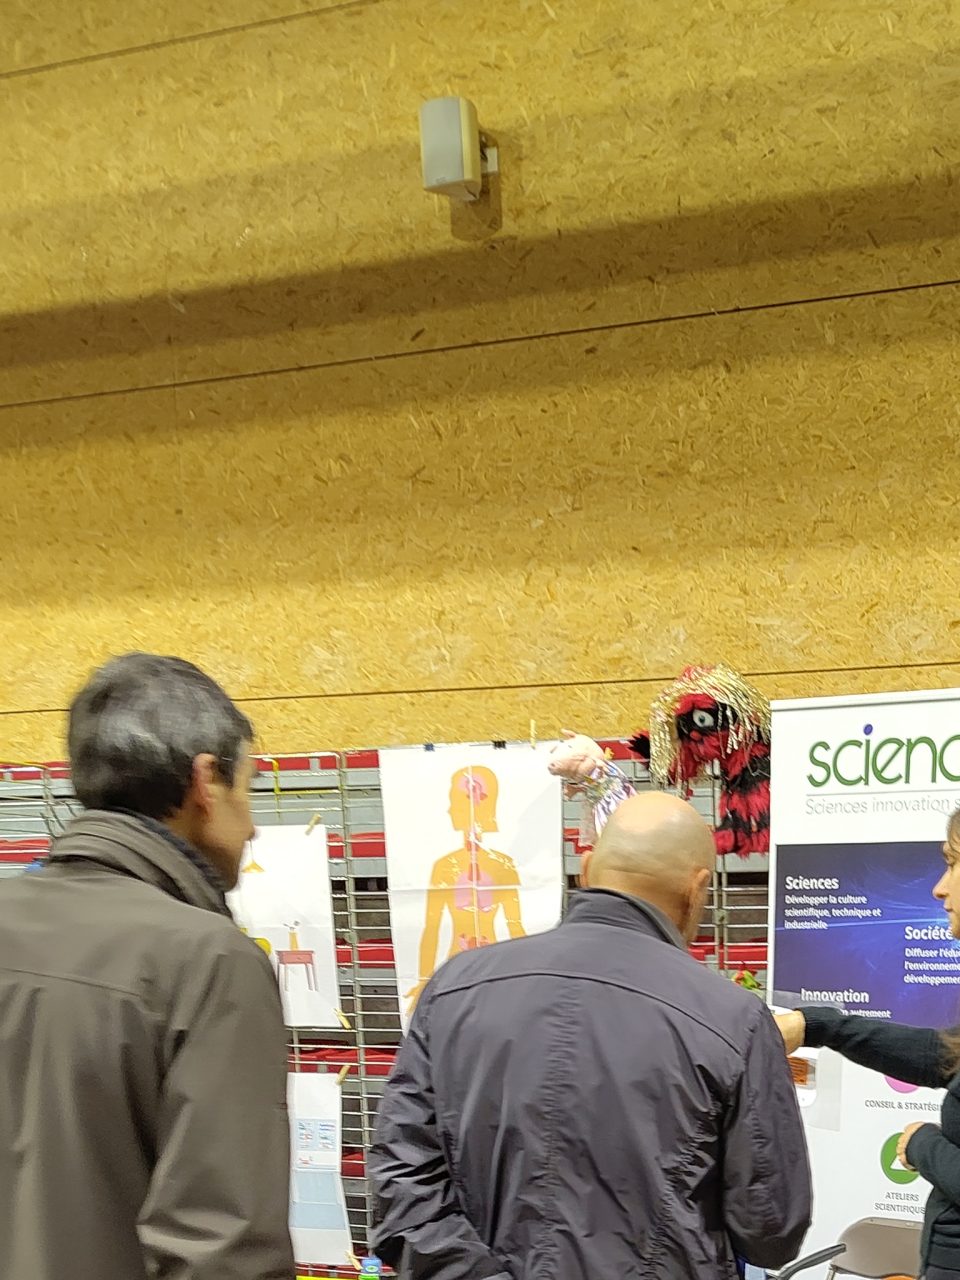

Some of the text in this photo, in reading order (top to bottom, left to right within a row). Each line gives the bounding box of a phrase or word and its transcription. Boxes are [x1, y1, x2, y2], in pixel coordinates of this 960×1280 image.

[805, 798, 868, 815] Sciences
[872, 795, 950, 812] innovation
[785, 875, 840, 890] Sciences
[784, 894, 868, 906] Développer la culture
[784, 907, 882, 919] scientifique, technique et
[784, 919, 828, 930] industrielle
[904, 925, 954, 940] Société
[905, 947, 939, 958] Diffuser
[801, 987, 869, 1003] Innovation
[850, 1009, 892, 1018] autrement
[865, 1099, 940, 1112] CONSEIL & STRATÉGI
[885, 1192, 920, 1202] ATELIERS
[874, 1202, 926, 1215] SCIENTIFIQUE
